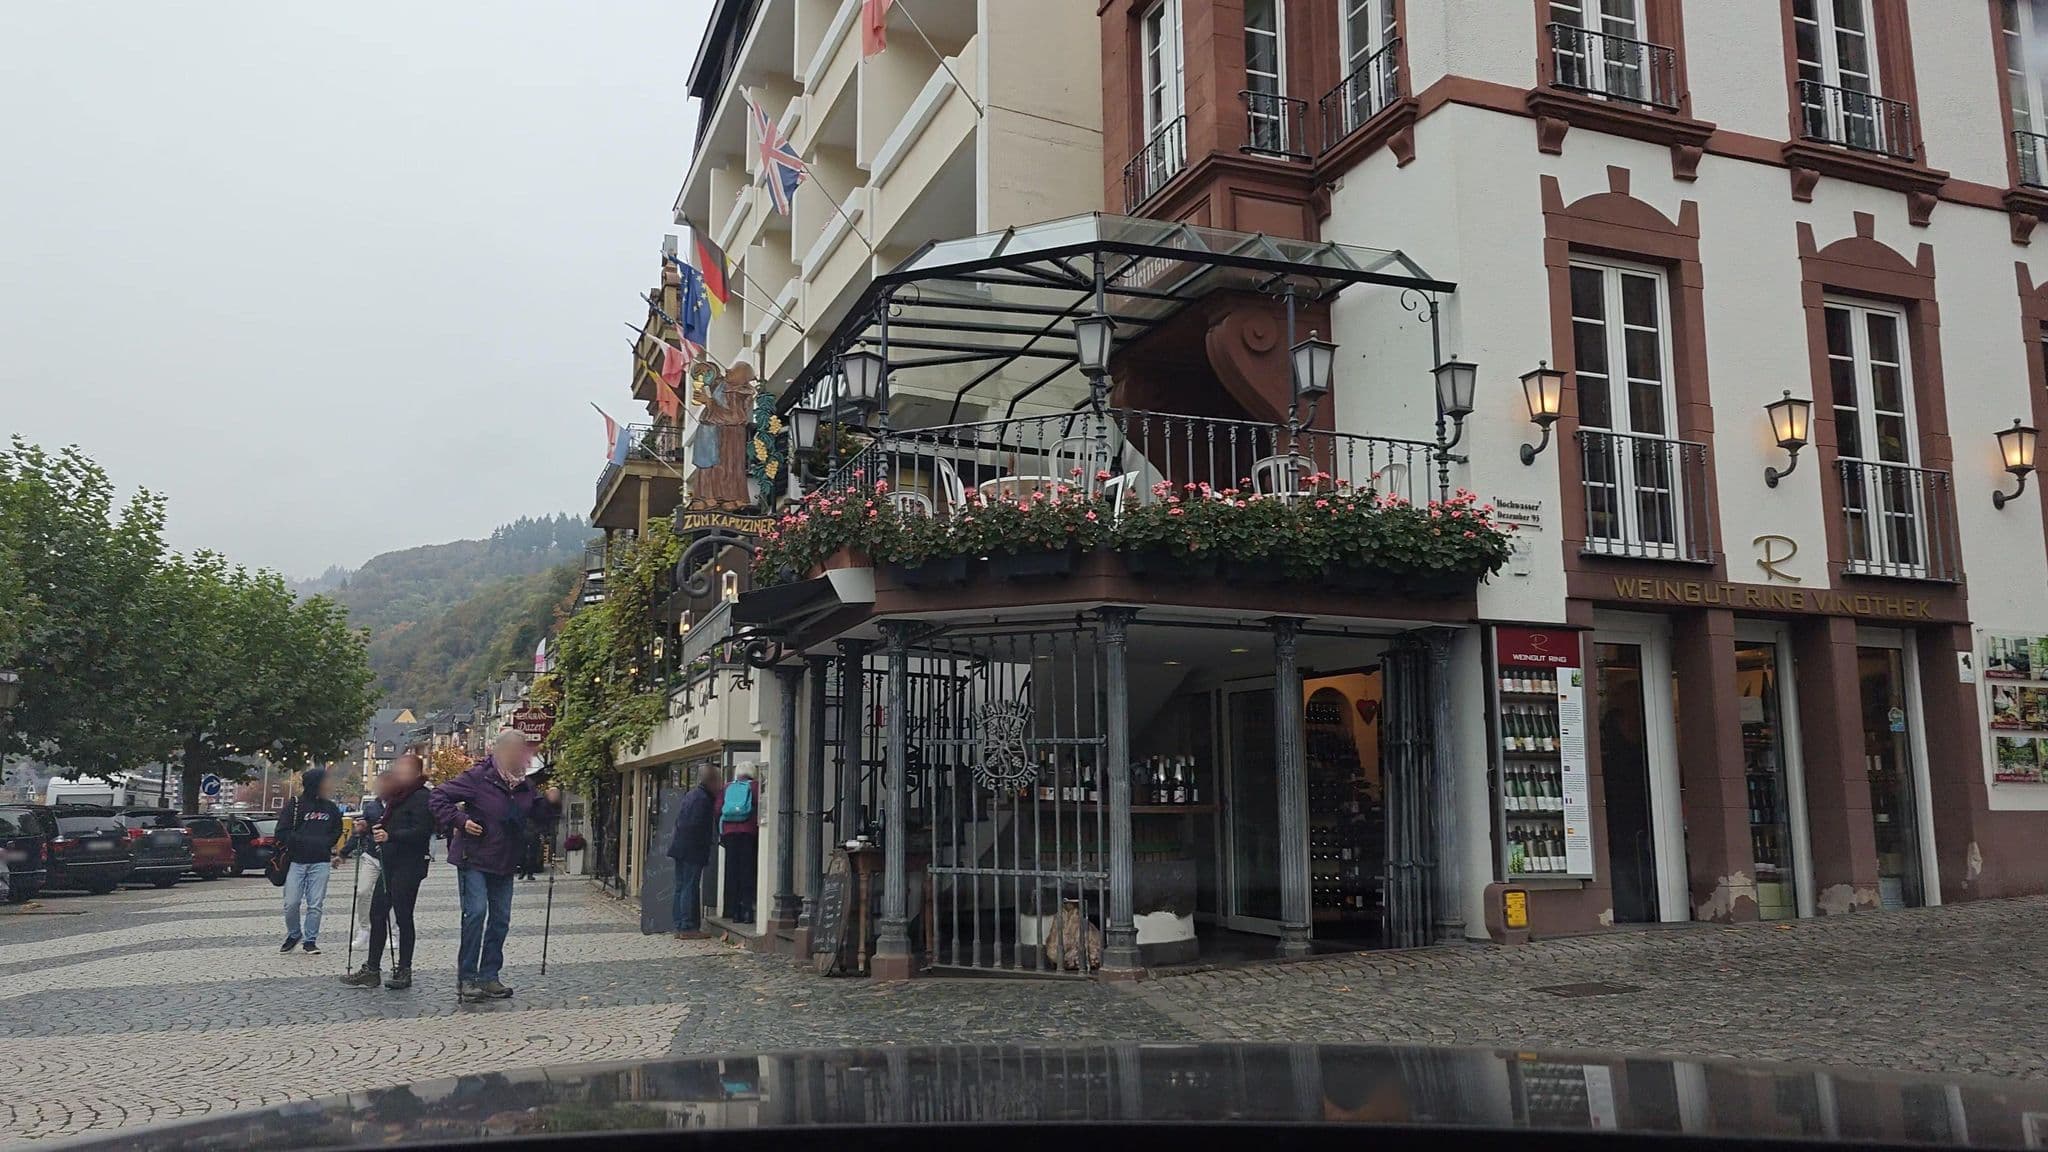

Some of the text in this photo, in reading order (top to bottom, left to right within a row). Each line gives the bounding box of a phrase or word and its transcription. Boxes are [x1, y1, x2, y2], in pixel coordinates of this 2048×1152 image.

[683, 514, 776, 534] ZUM KAPUZINER
[1613, 576, 1934, 619] WEINGUT RING VINOTHEK
[1548, 655, 1567, 663] RING
